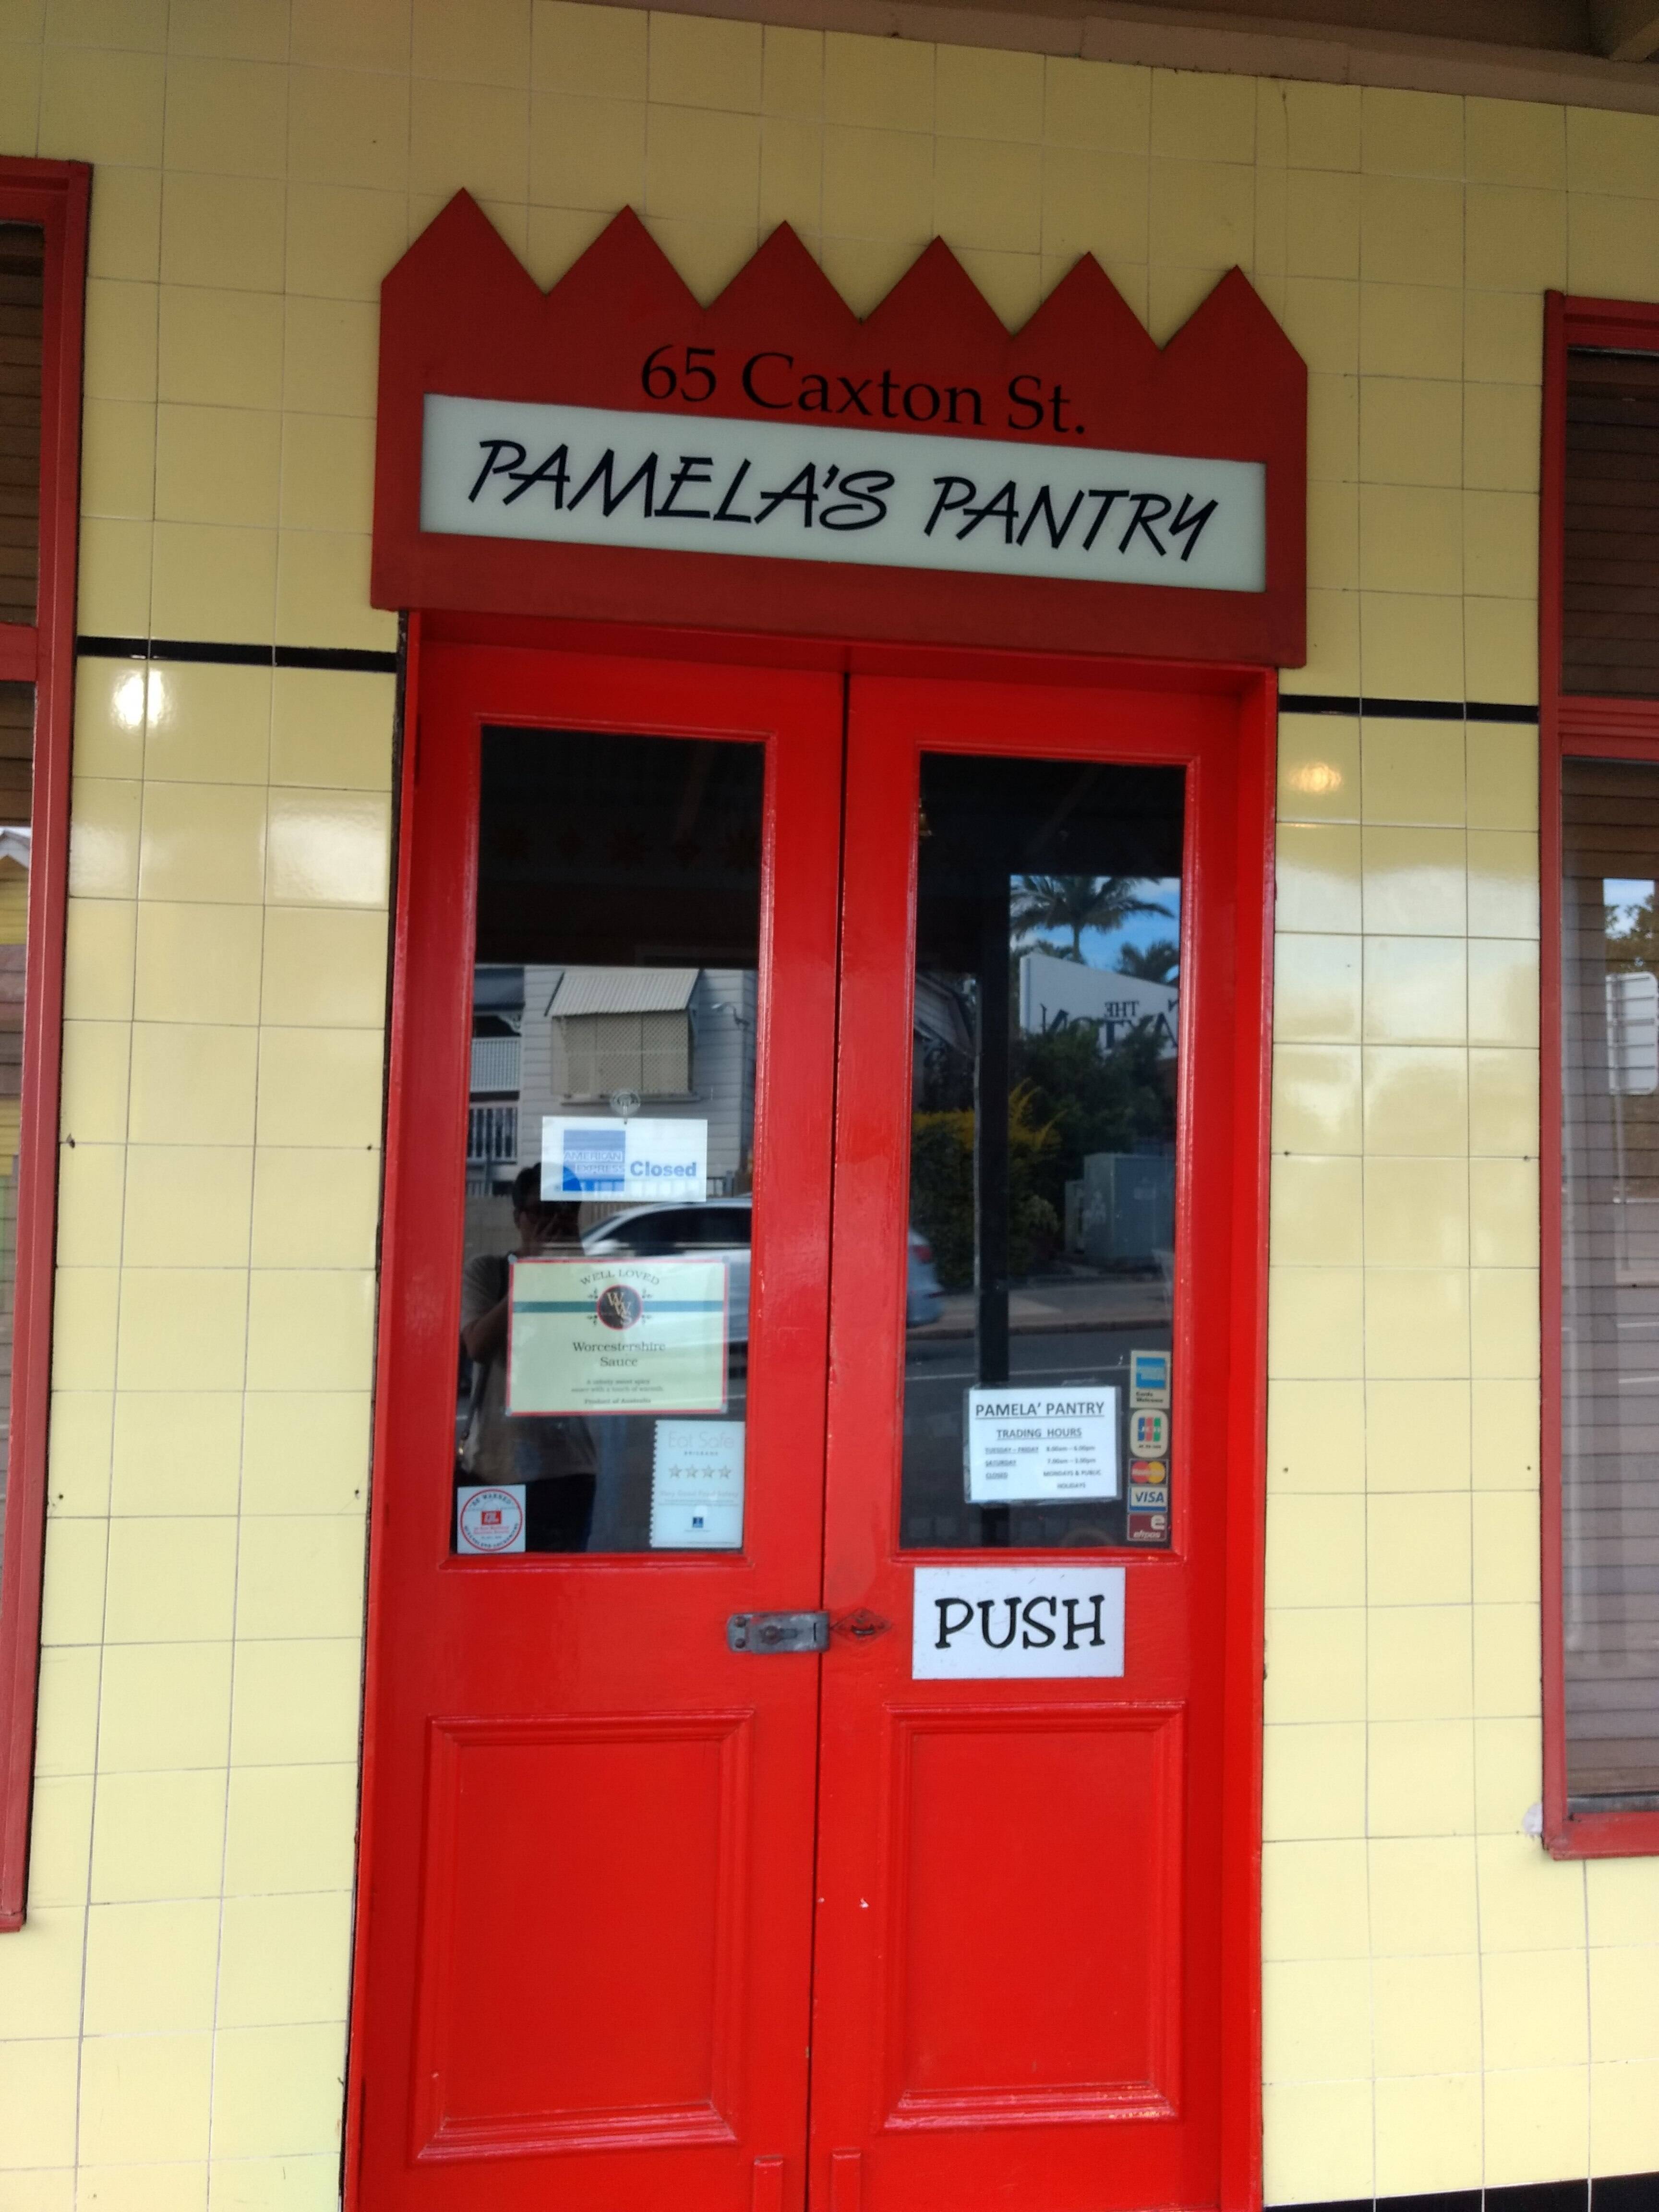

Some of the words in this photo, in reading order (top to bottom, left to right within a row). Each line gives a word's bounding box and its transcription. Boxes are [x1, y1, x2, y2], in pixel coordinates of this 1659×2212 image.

[641, 344, 717, 402] 65
[742, 352, 987, 426] Caxton
[1008, 374, 1085, 434] St.
[469, 439, 896, 531] PAMELA'S
[924, 476, 1219, 562] PANTRY
[630, 1161, 697, 1177] Closed
[580, 1270, 615, 1285] WELL
[619, 1269, 660, 1285] LOVED
[572, 1341, 666, 1352] Worcestershire
[600, 1357, 638, 1367] Sauce
[1046, 1402, 1105, 1415] PANTRY
[997, 1429, 1042, 1439] TRADING
[1047, 1428, 1082, 1437] HOURS
[1135, 1491, 1164, 1503] VISA
[935, 1594, 1106, 1650] PUSH
